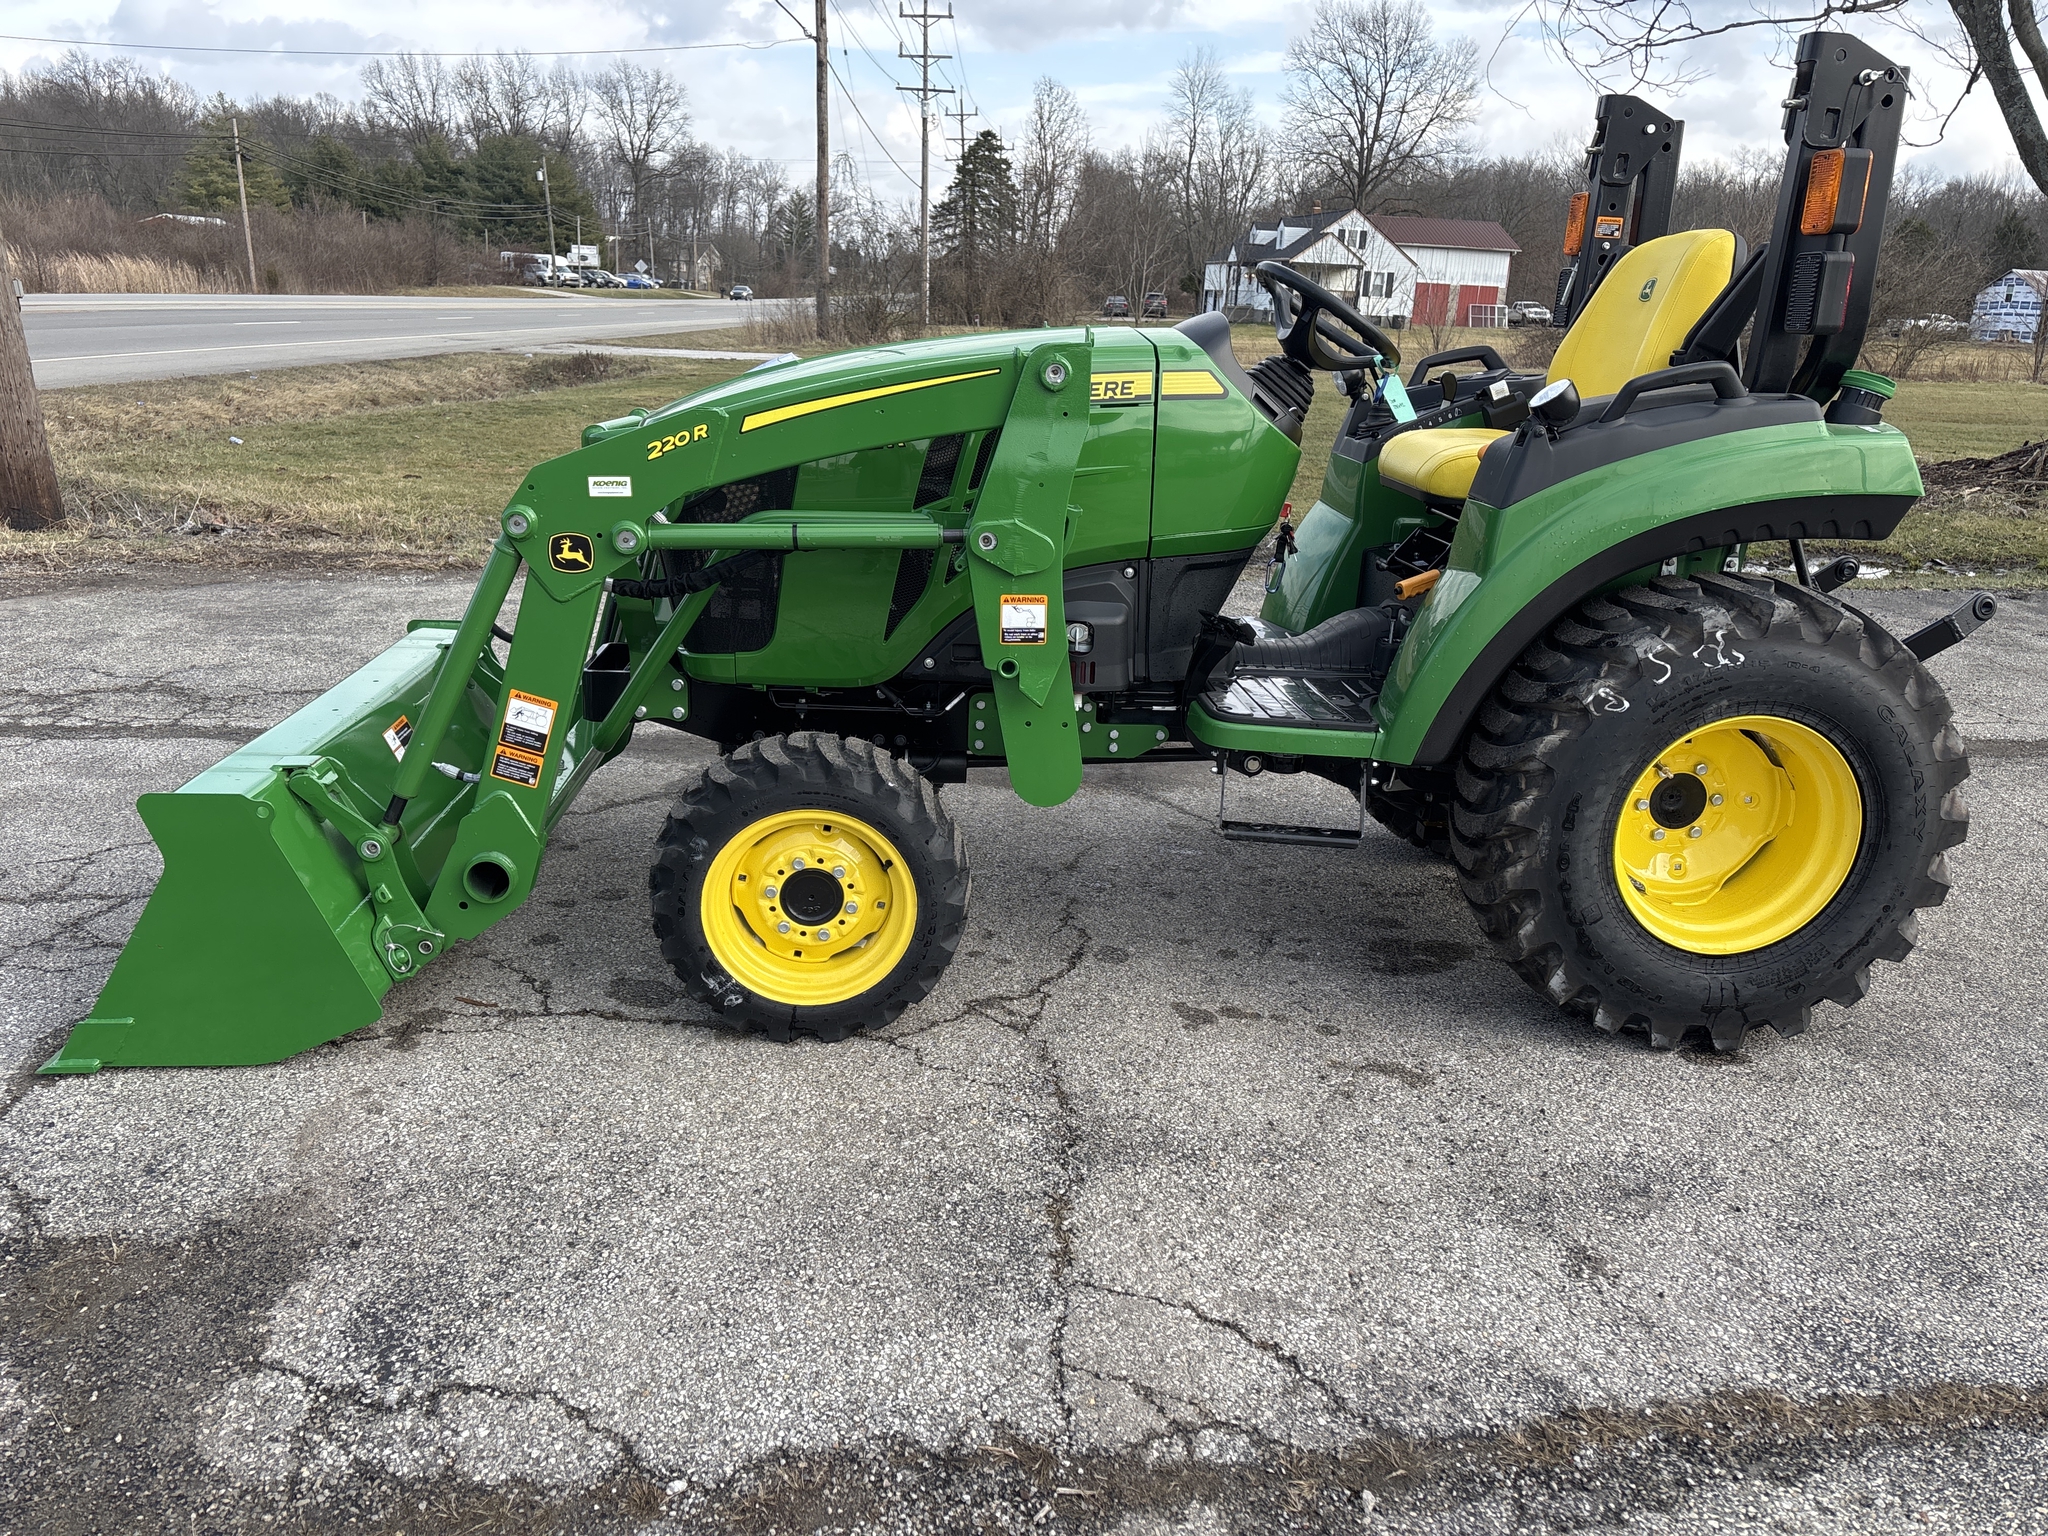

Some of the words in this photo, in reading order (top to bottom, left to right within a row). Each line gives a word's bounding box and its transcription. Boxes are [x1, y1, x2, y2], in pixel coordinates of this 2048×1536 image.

[522, 694, 552, 707] WARNING
[509, 751, 538, 764] WARNING
[1877, 703, 1925, 843] GALAXY
[1556, 791, 1616, 975] MARATHONER
